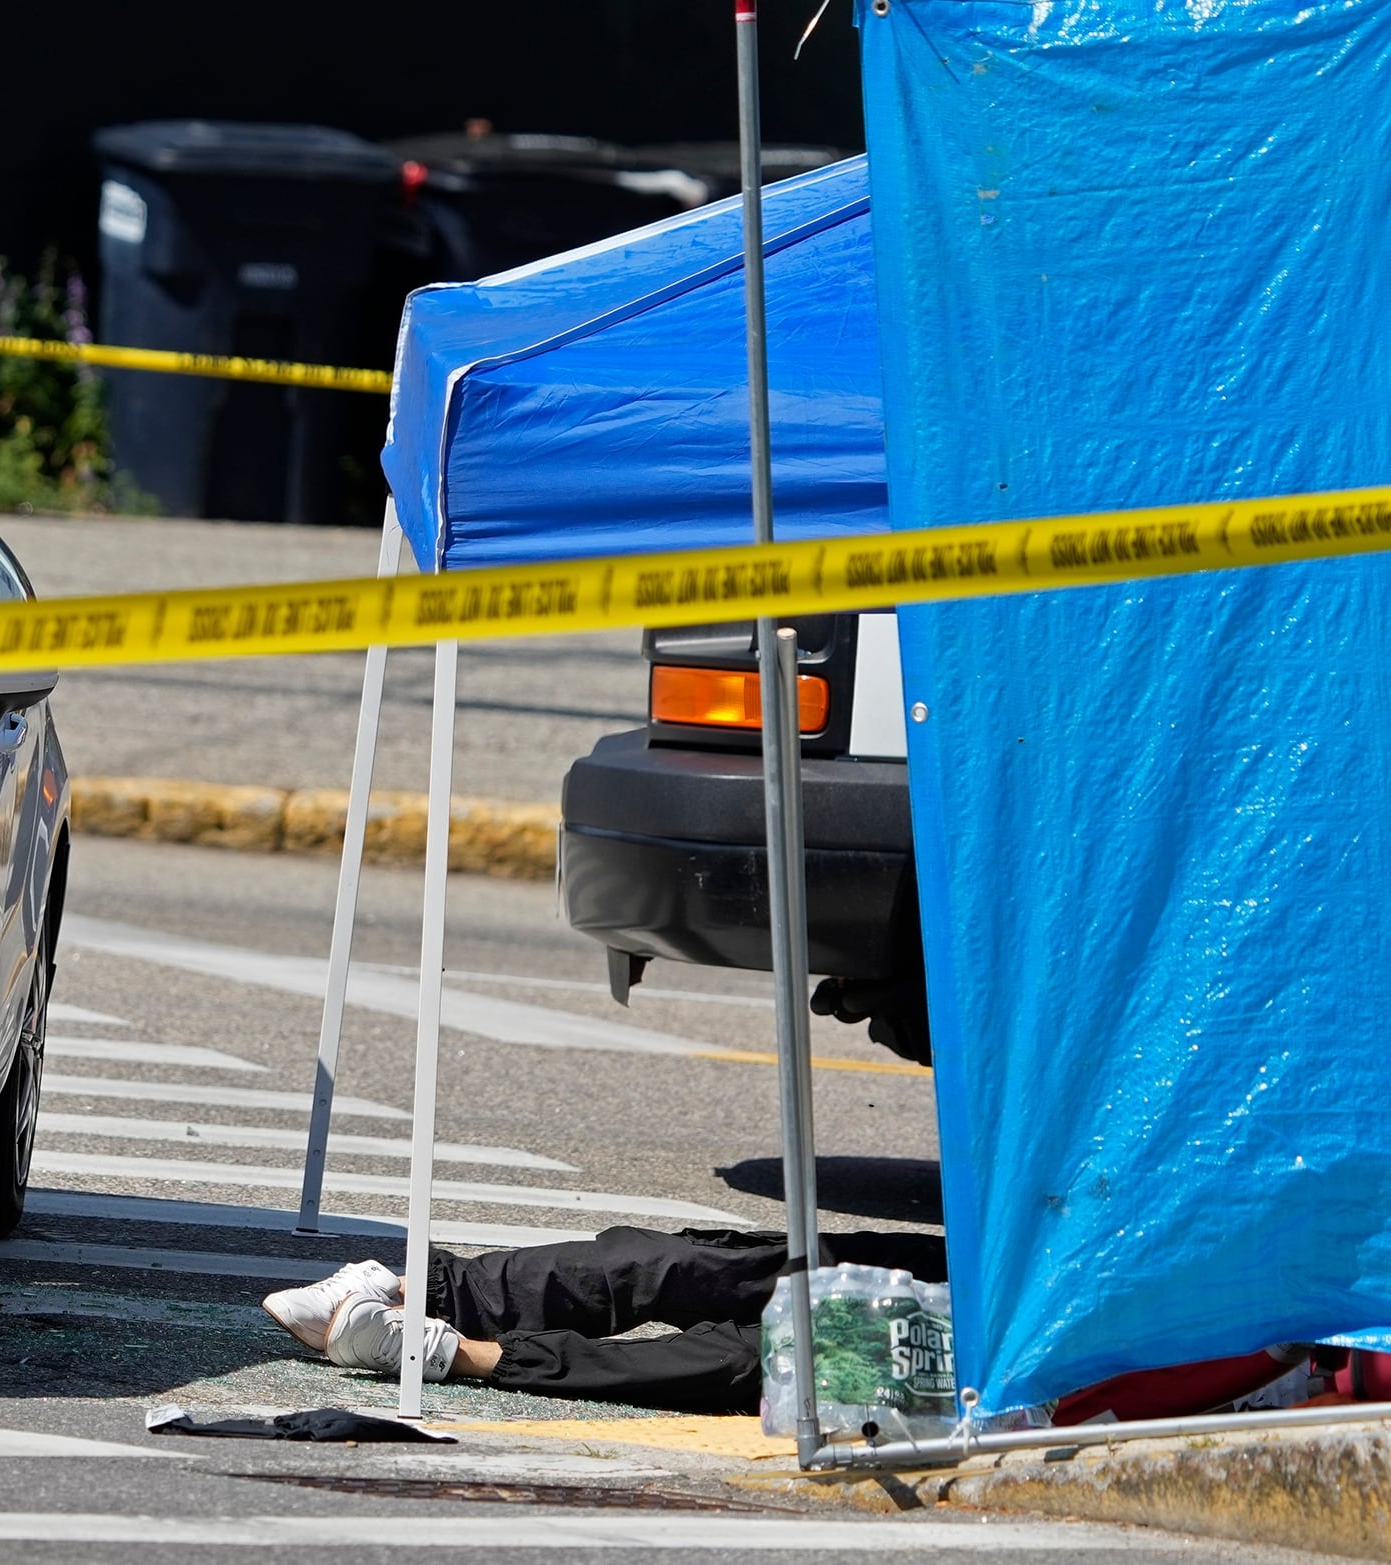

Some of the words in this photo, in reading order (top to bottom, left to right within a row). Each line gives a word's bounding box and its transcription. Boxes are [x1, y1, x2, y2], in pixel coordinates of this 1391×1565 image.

[889, 1318, 953, 1351] Polar
[891, 1346, 954, 1380] Sprin
[935, 1377, 956, 1389] WATE
